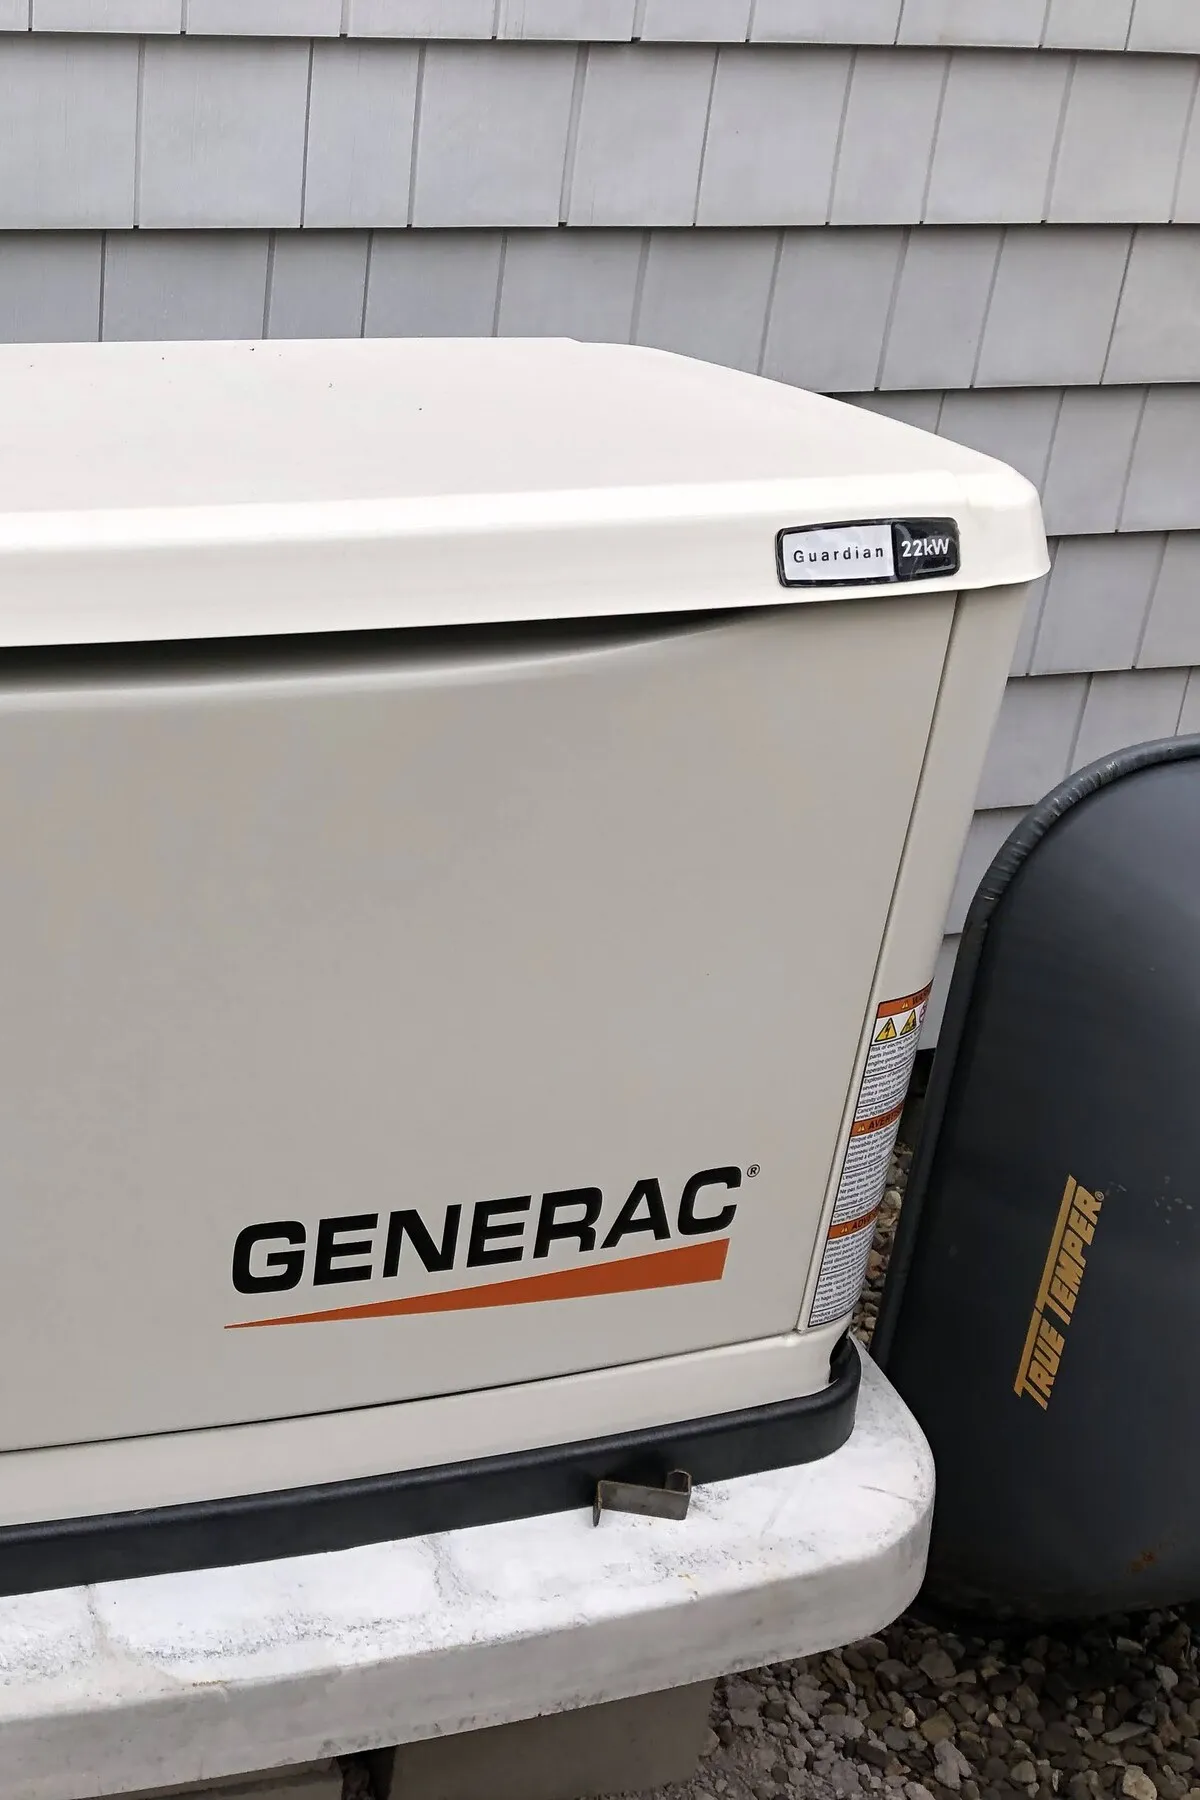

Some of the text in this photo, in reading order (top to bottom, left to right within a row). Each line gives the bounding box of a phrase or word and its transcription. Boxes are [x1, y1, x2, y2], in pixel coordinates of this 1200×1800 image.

[793, 538, 950, 563] Guardian 22kW
[232, 1165, 742, 1294] GENERAC
[1013, 1174, 1102, 1411] TRUE TEMPER
